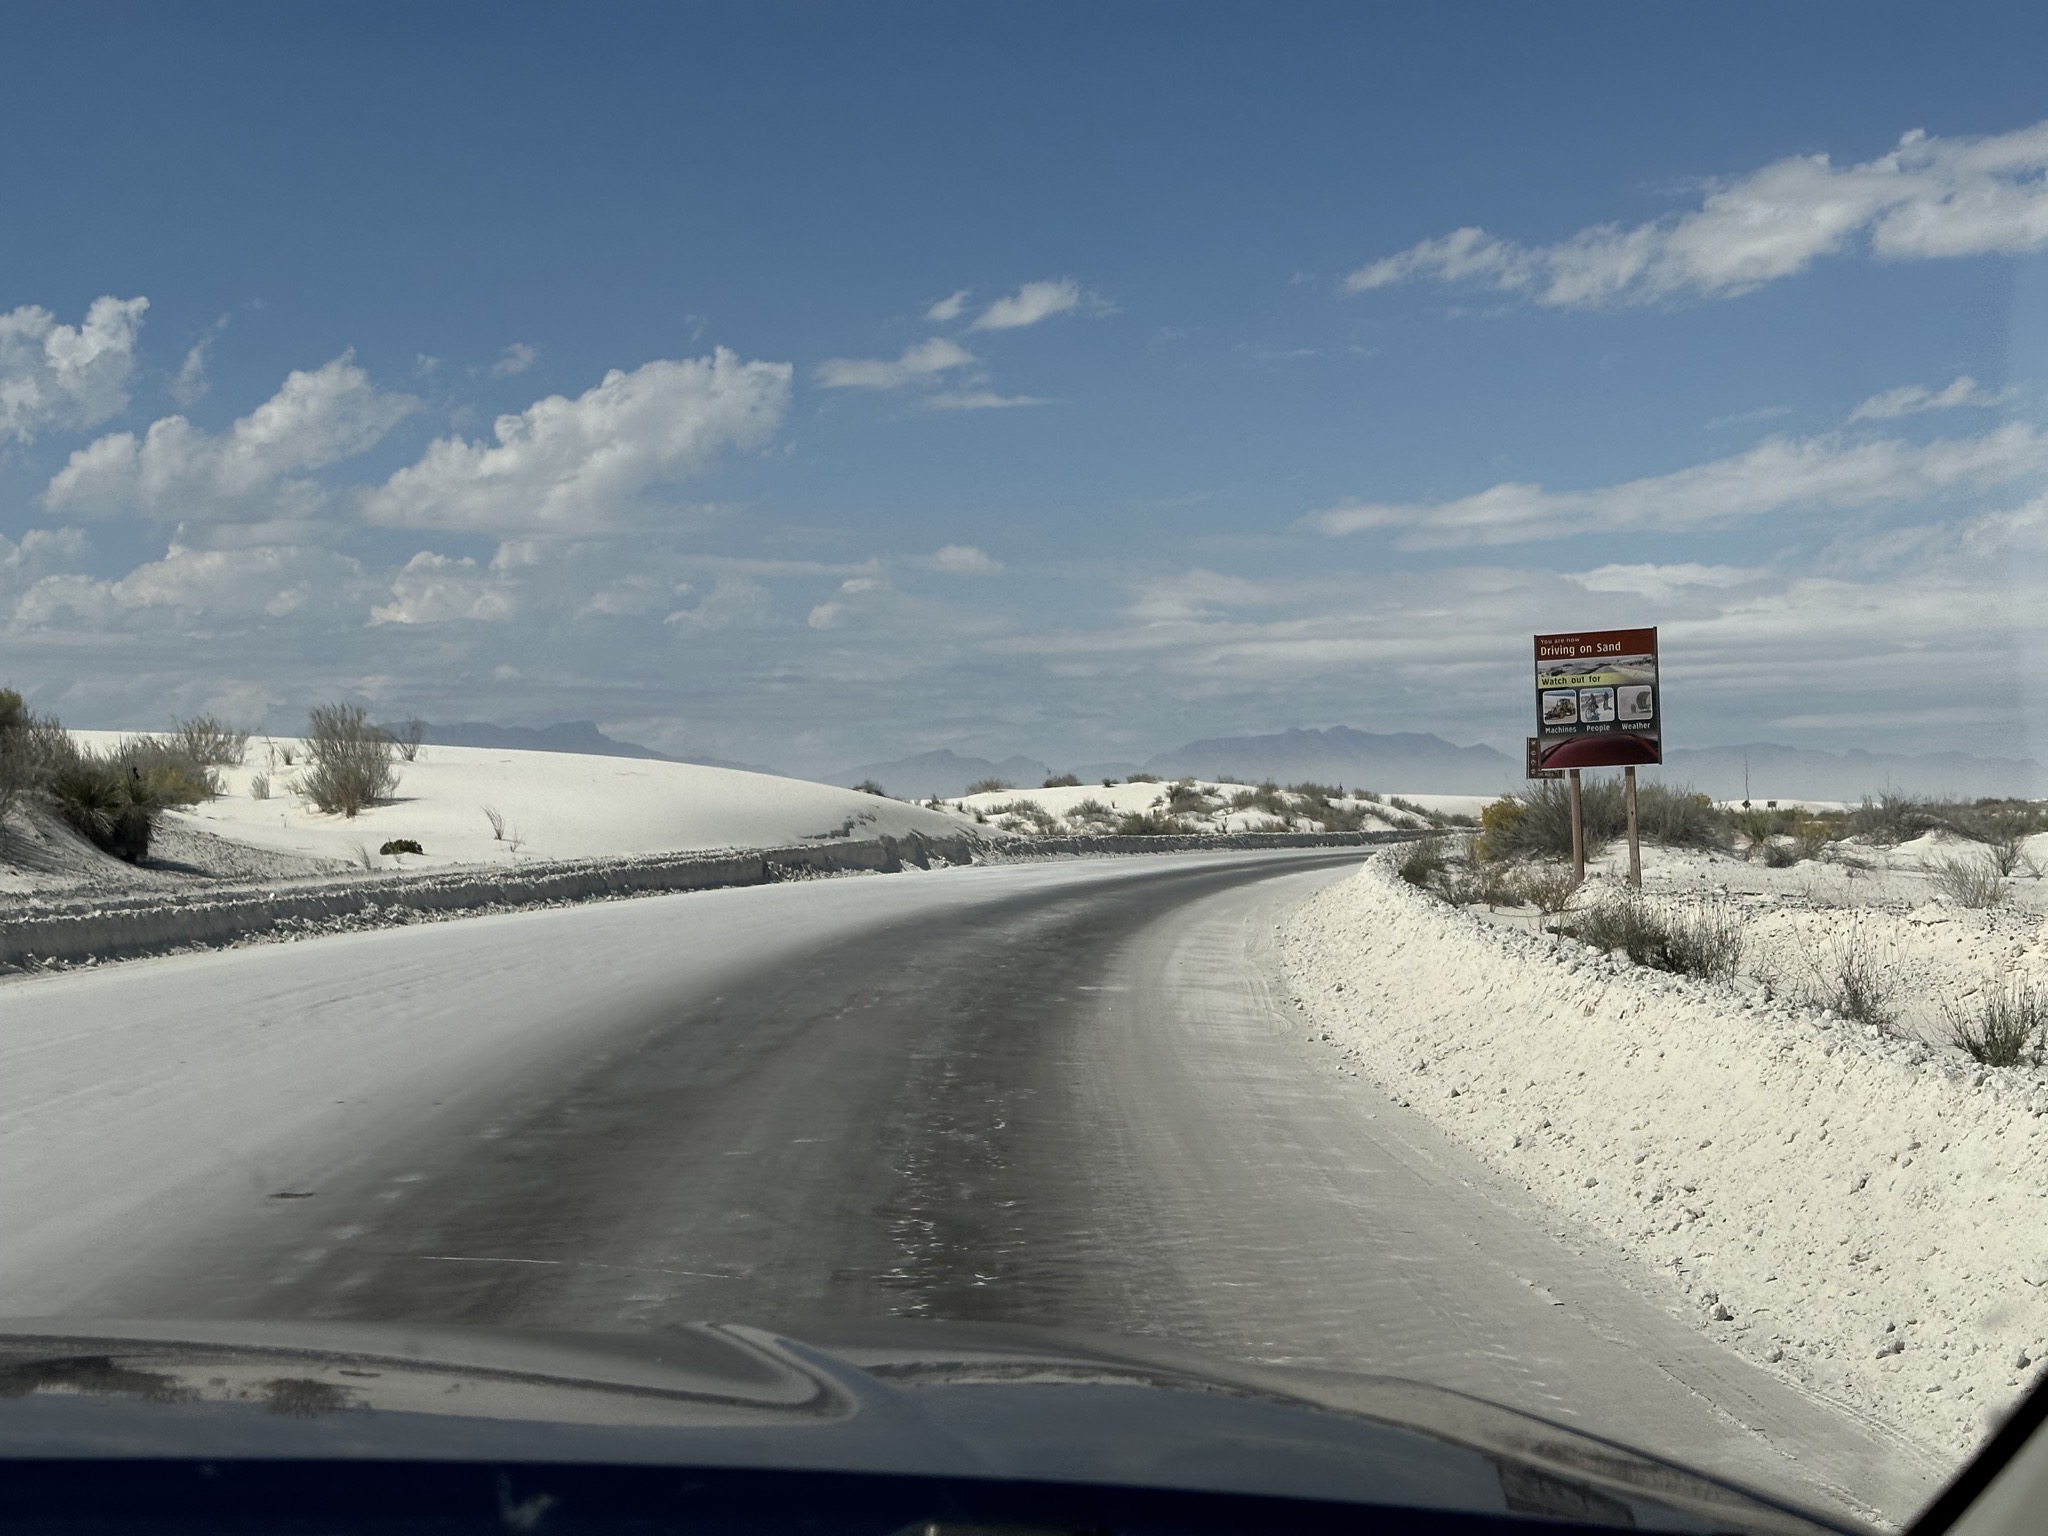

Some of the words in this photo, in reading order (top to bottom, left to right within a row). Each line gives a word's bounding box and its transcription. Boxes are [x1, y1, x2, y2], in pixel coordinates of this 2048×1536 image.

[1540, 645, 1575, 656] Driving
[1580, 644, 1592, 653] on
[1596, 641, 1621, 652] Sand
[1541, 677, 1567, 686] Watch
[1571, 676, 1585, 684] out
[1589, 675, 1601, 683] for
[1545, 726, 1577, 734] Machines
[1586, 724, 1610, 732] People
[1621, 722, 1651, 730] Weather
